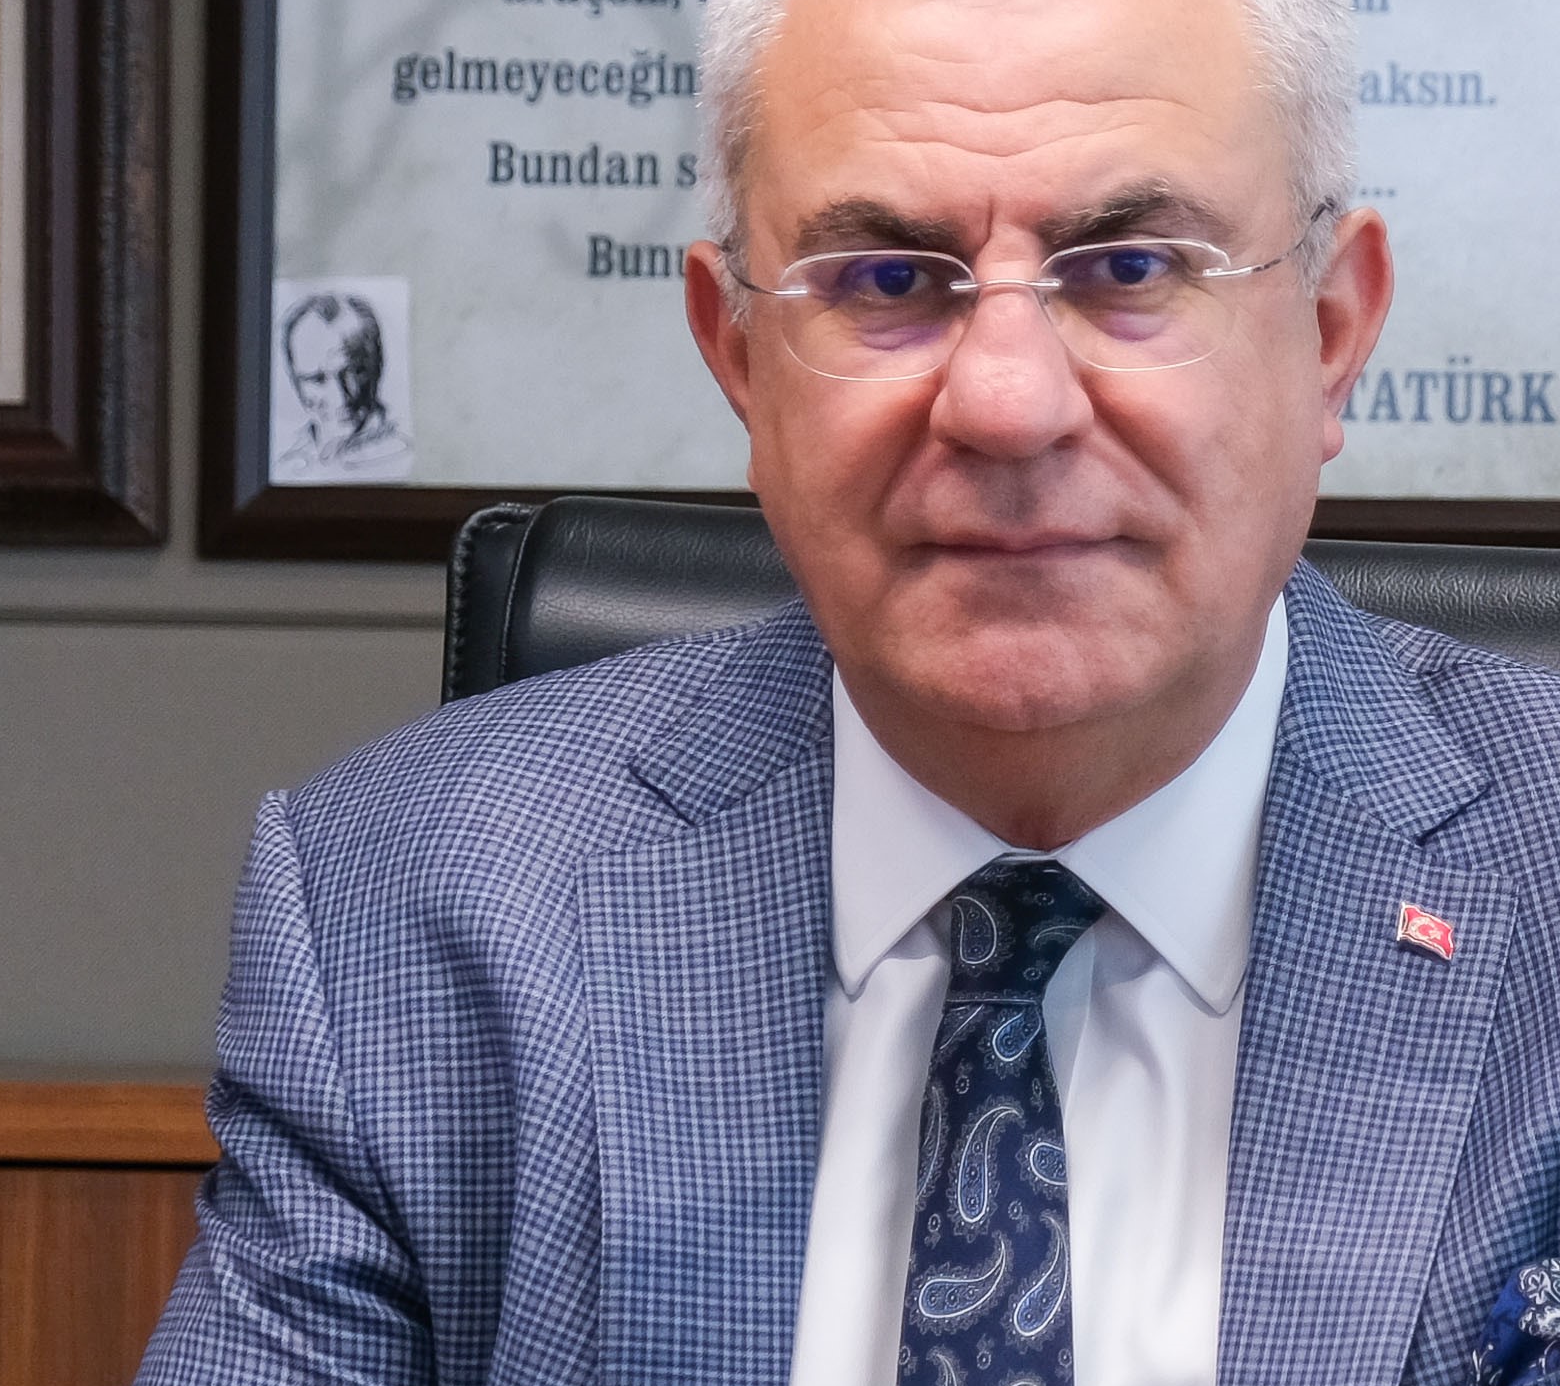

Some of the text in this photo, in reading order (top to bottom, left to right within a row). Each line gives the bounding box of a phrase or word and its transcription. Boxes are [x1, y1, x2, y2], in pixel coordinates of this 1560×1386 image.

[392, 48, 1497, 107] gelmeyeceğin aksın.
[487, 140, 661, 186] Bundan
